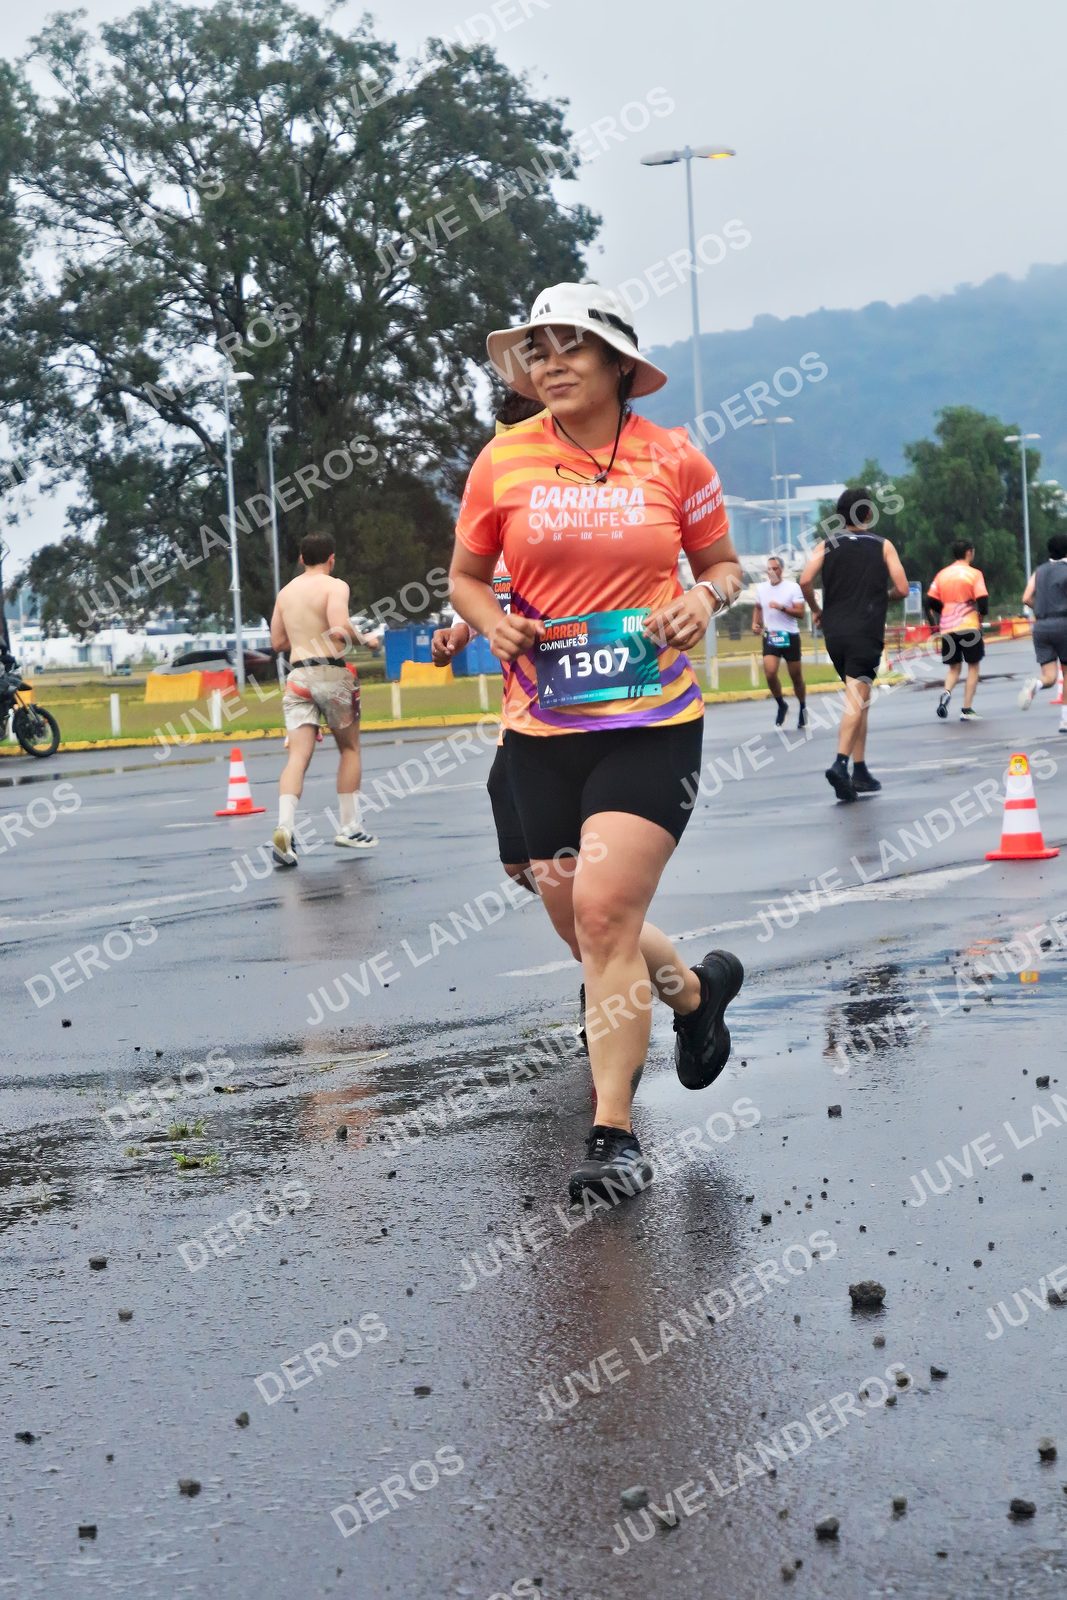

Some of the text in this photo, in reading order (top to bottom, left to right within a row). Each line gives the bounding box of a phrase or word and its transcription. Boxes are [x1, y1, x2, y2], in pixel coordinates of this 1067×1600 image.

[530, 485, 645, 509] CARRERA
[622, 615, 644, 633] 10K
[558, 647, 630, 679] 1307
